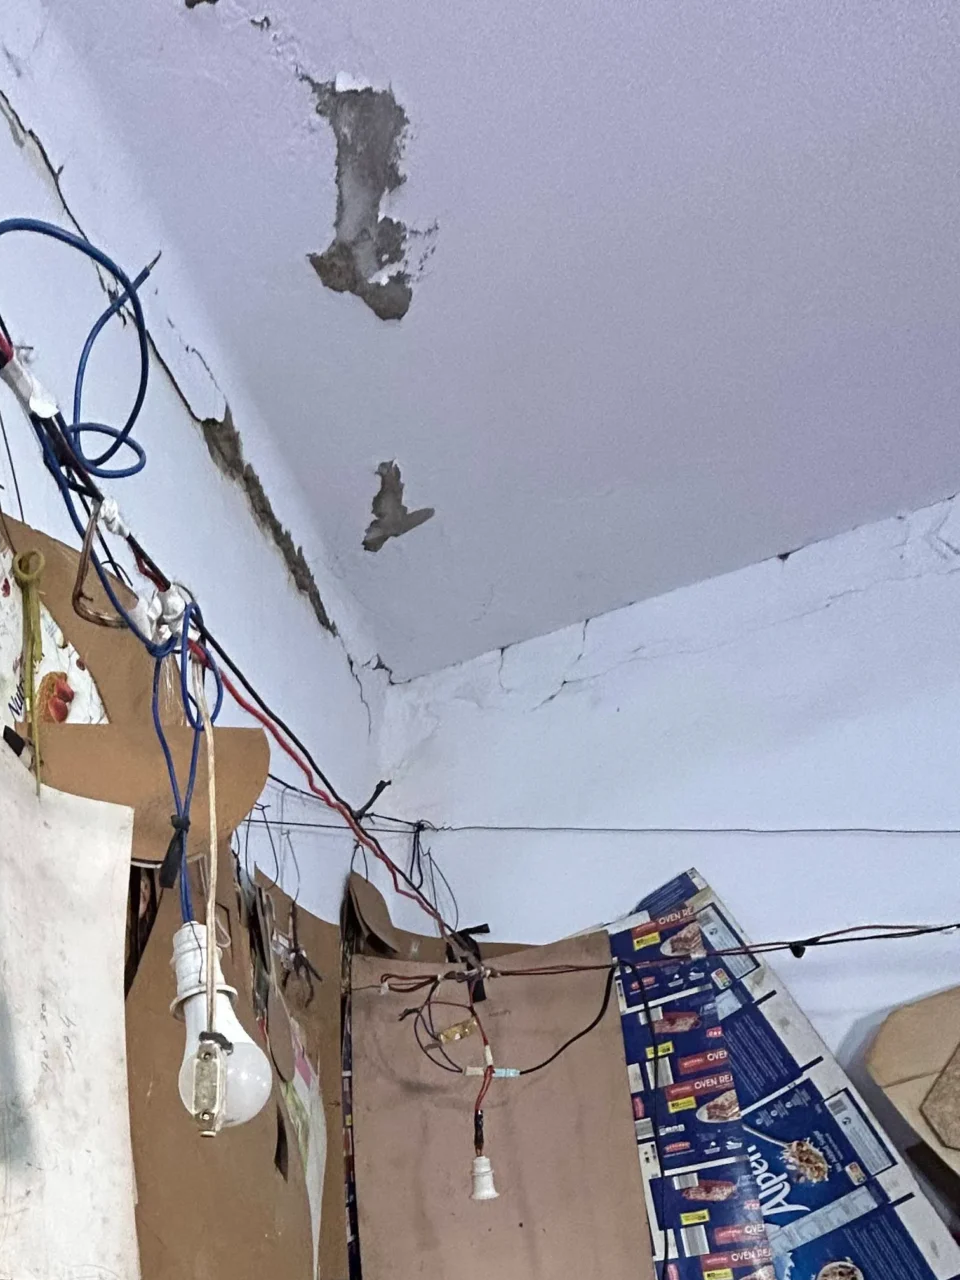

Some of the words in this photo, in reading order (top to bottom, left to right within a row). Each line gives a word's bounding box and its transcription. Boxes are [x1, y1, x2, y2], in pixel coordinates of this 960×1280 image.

[658, 912, 681, 925] OVEN
[695, 1077, 718, 1090] OVEN
[731, 1251, 755, 1262] OVEN
